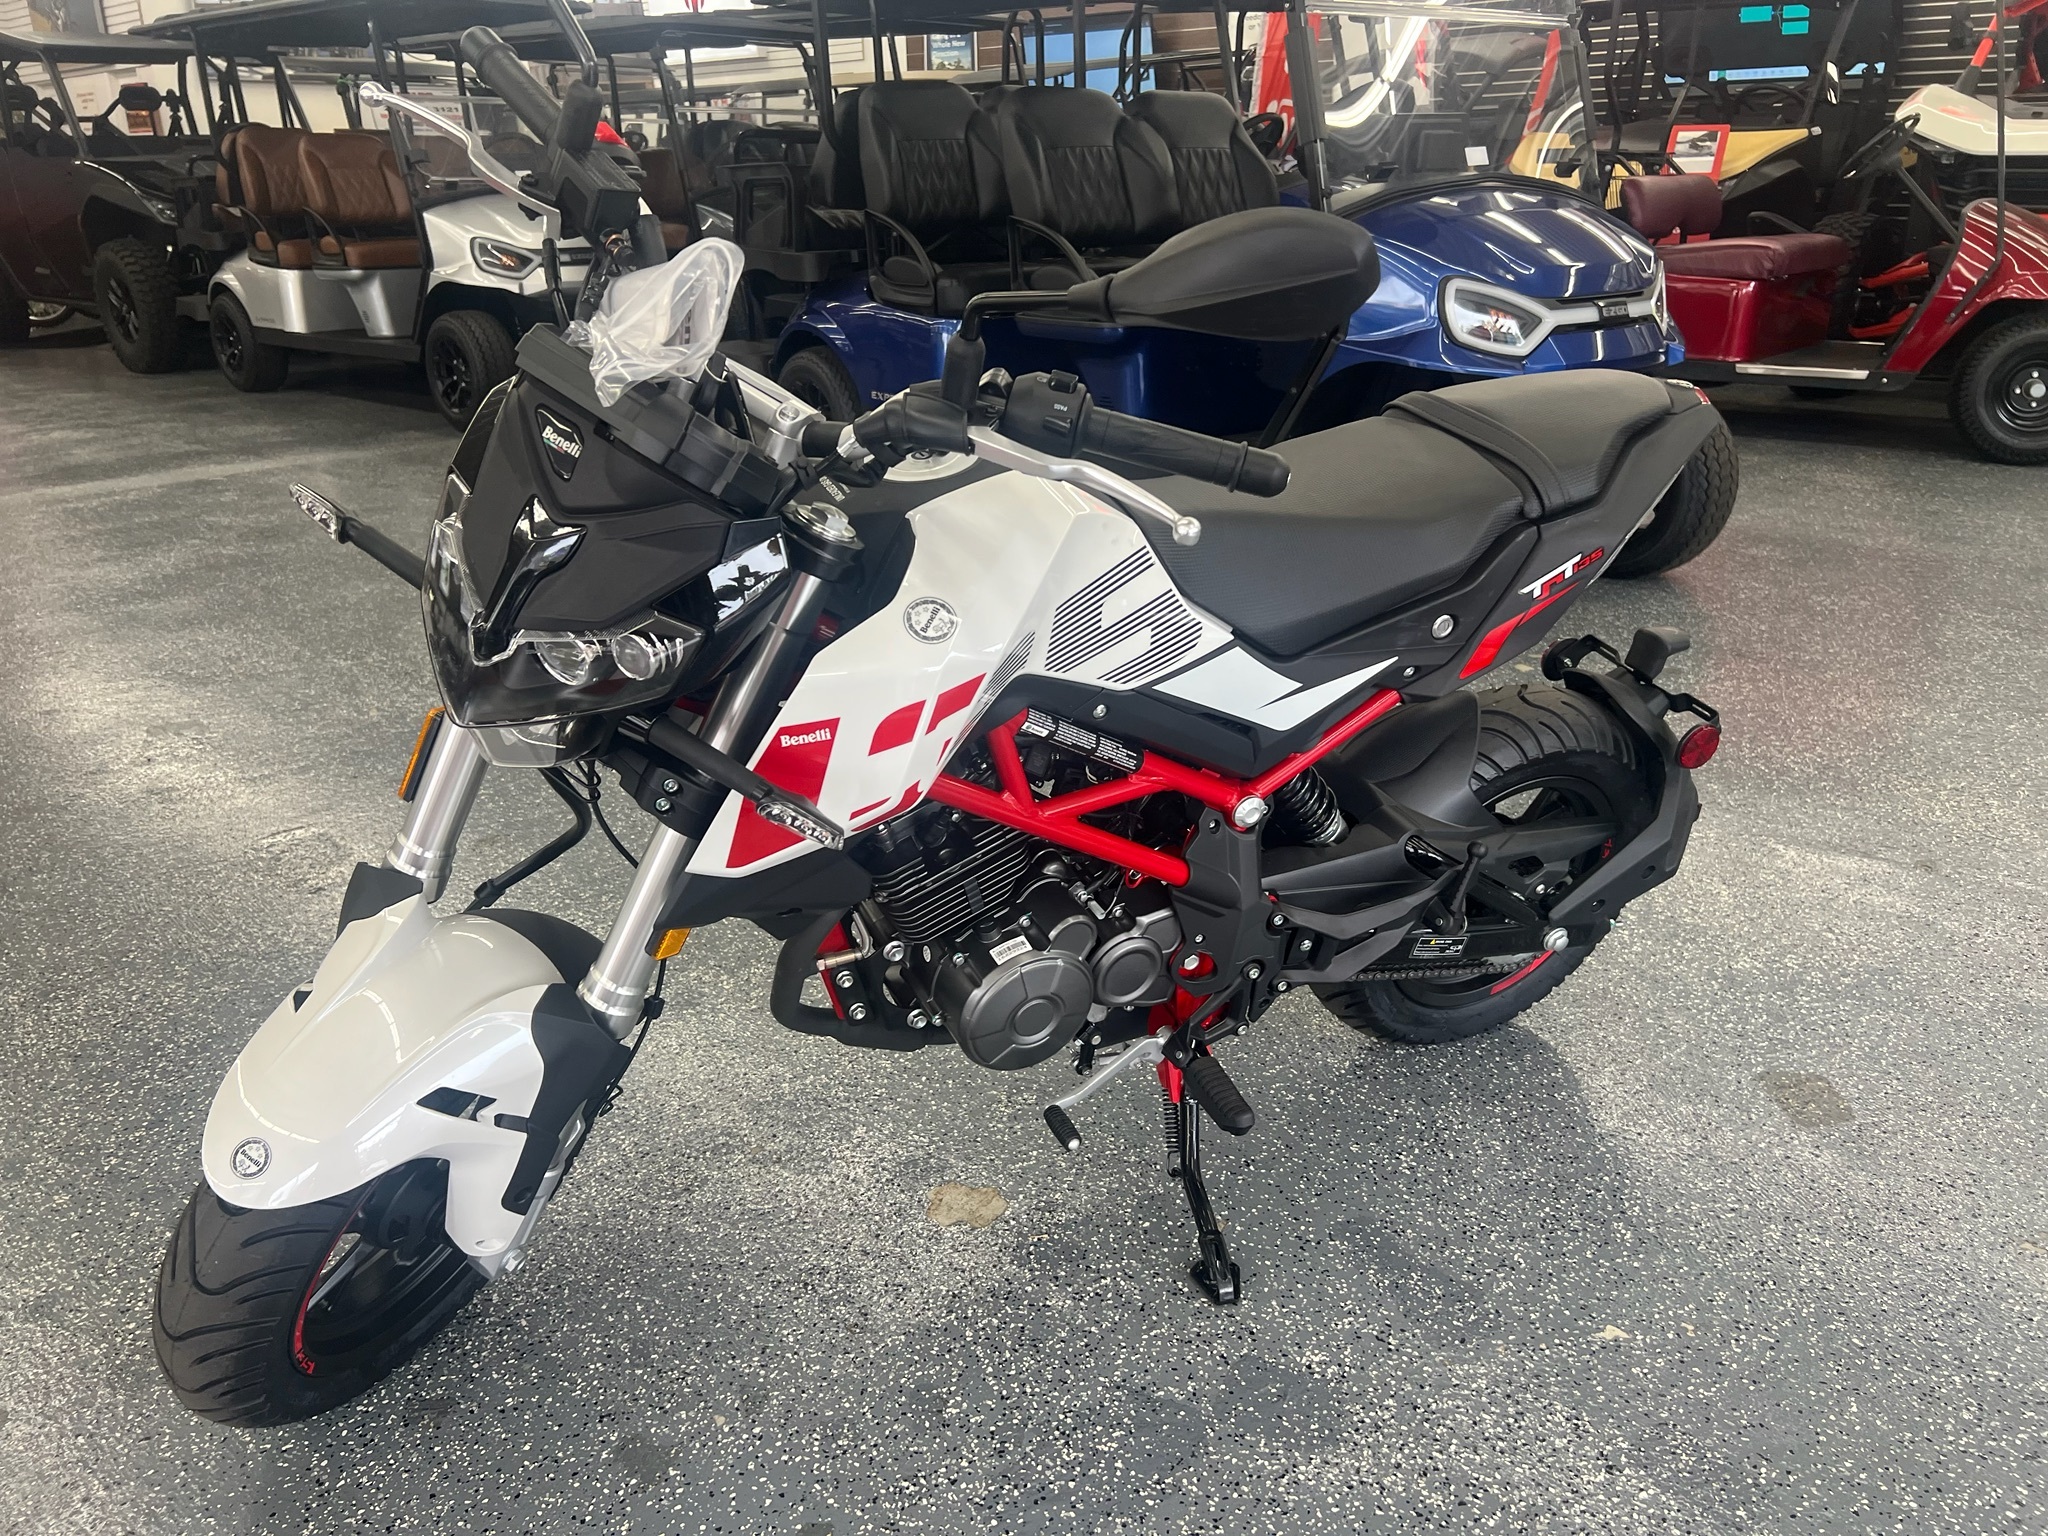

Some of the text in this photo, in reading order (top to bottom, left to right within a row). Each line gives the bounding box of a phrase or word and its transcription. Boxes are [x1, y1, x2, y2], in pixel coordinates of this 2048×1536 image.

[542, 425, 582, 458] Benelli
[920, 606, 941, 634] Benelli
[780, 727, 832, 748] Benelli
[239, 1148, 262, 1168] Benelli
